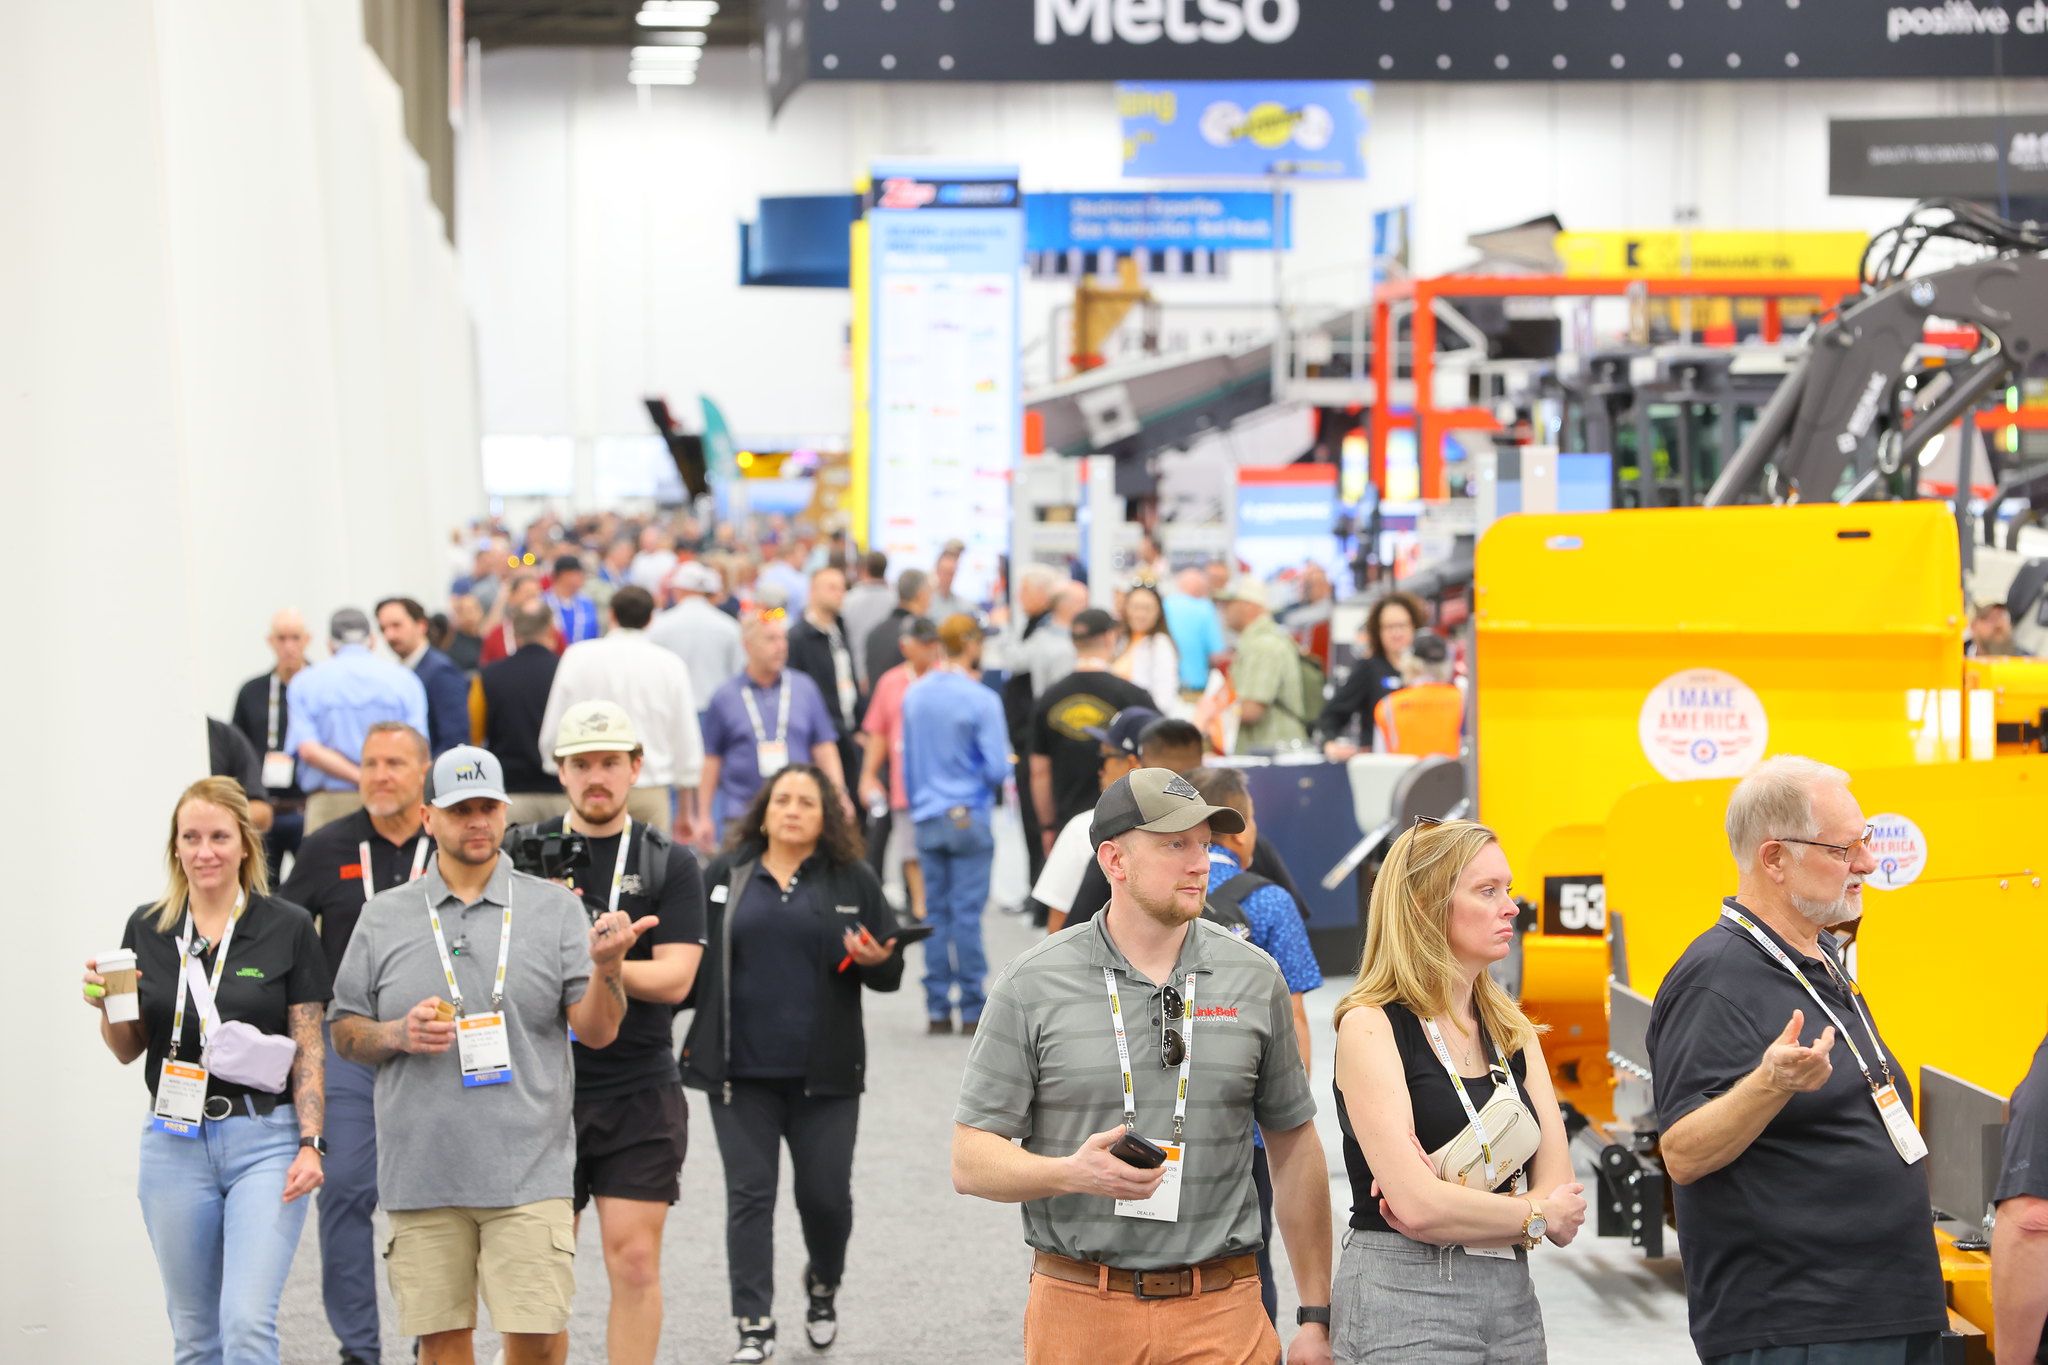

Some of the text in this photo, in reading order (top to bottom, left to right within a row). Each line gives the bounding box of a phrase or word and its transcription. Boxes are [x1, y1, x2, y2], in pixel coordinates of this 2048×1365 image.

[1034, 0, 1300, 45] Metso
[1680, 687, 1735, 708] MAKE
[1658, 711, 1749, 730] AMERICA
[1874, 825, 1907, 839] MAKE
[1869, 840, 1917, 853] MERICA
[1560, 883, 1606, 930] 53
